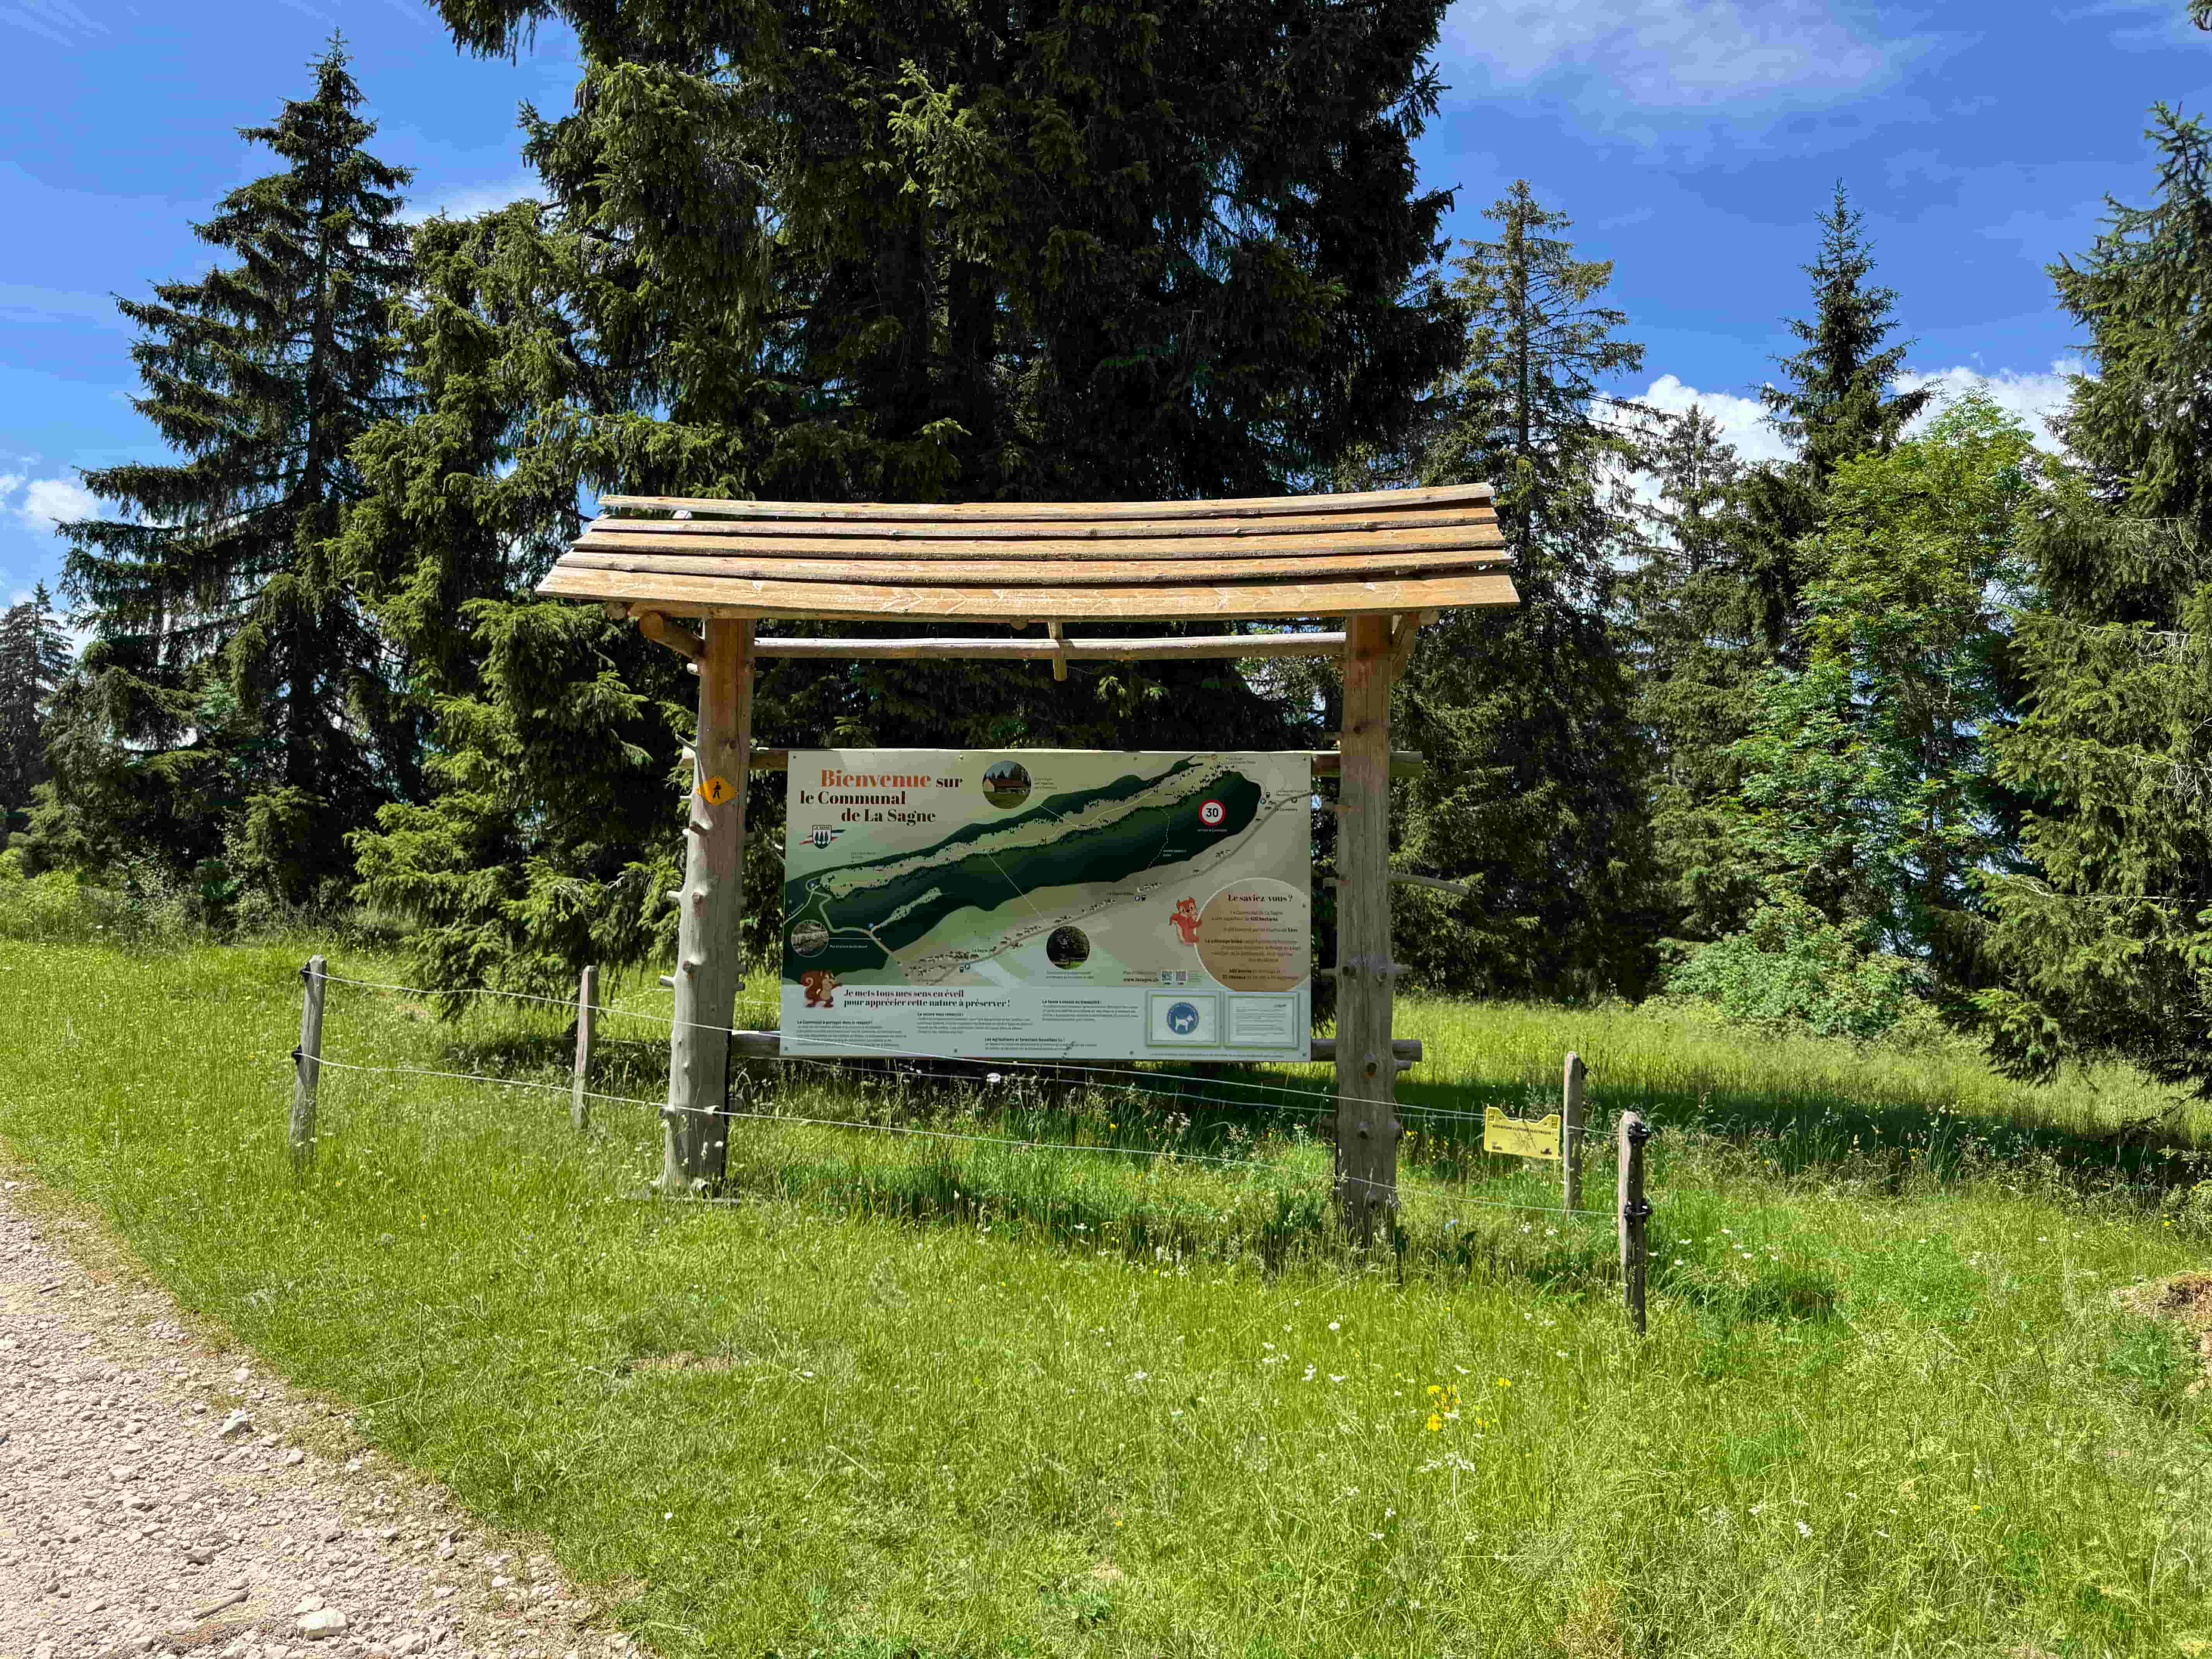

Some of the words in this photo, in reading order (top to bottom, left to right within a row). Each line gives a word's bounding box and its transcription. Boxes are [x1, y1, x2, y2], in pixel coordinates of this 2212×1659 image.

[821, 768, 931, 787] Bienvenue
[936, 778, 963, 788] sur
[800, 790, 814, 804] le
[818, 790, 906, 805] Communal
[841, 808, 860, 822] de
[864, 809, 883, 822] La
[887, 809, 936, 826] Sagne
[1206, 808, 1219, 817] 30
[1228, 894, 1238, 902] Le
[844, 989, 853, 998] Je
[945, 988, 964, 998] éveil
[844, 1000, 865, 1008] pour
[866, 998, 906, 1009] apprécier
[958, 998, 963, 1007] à
